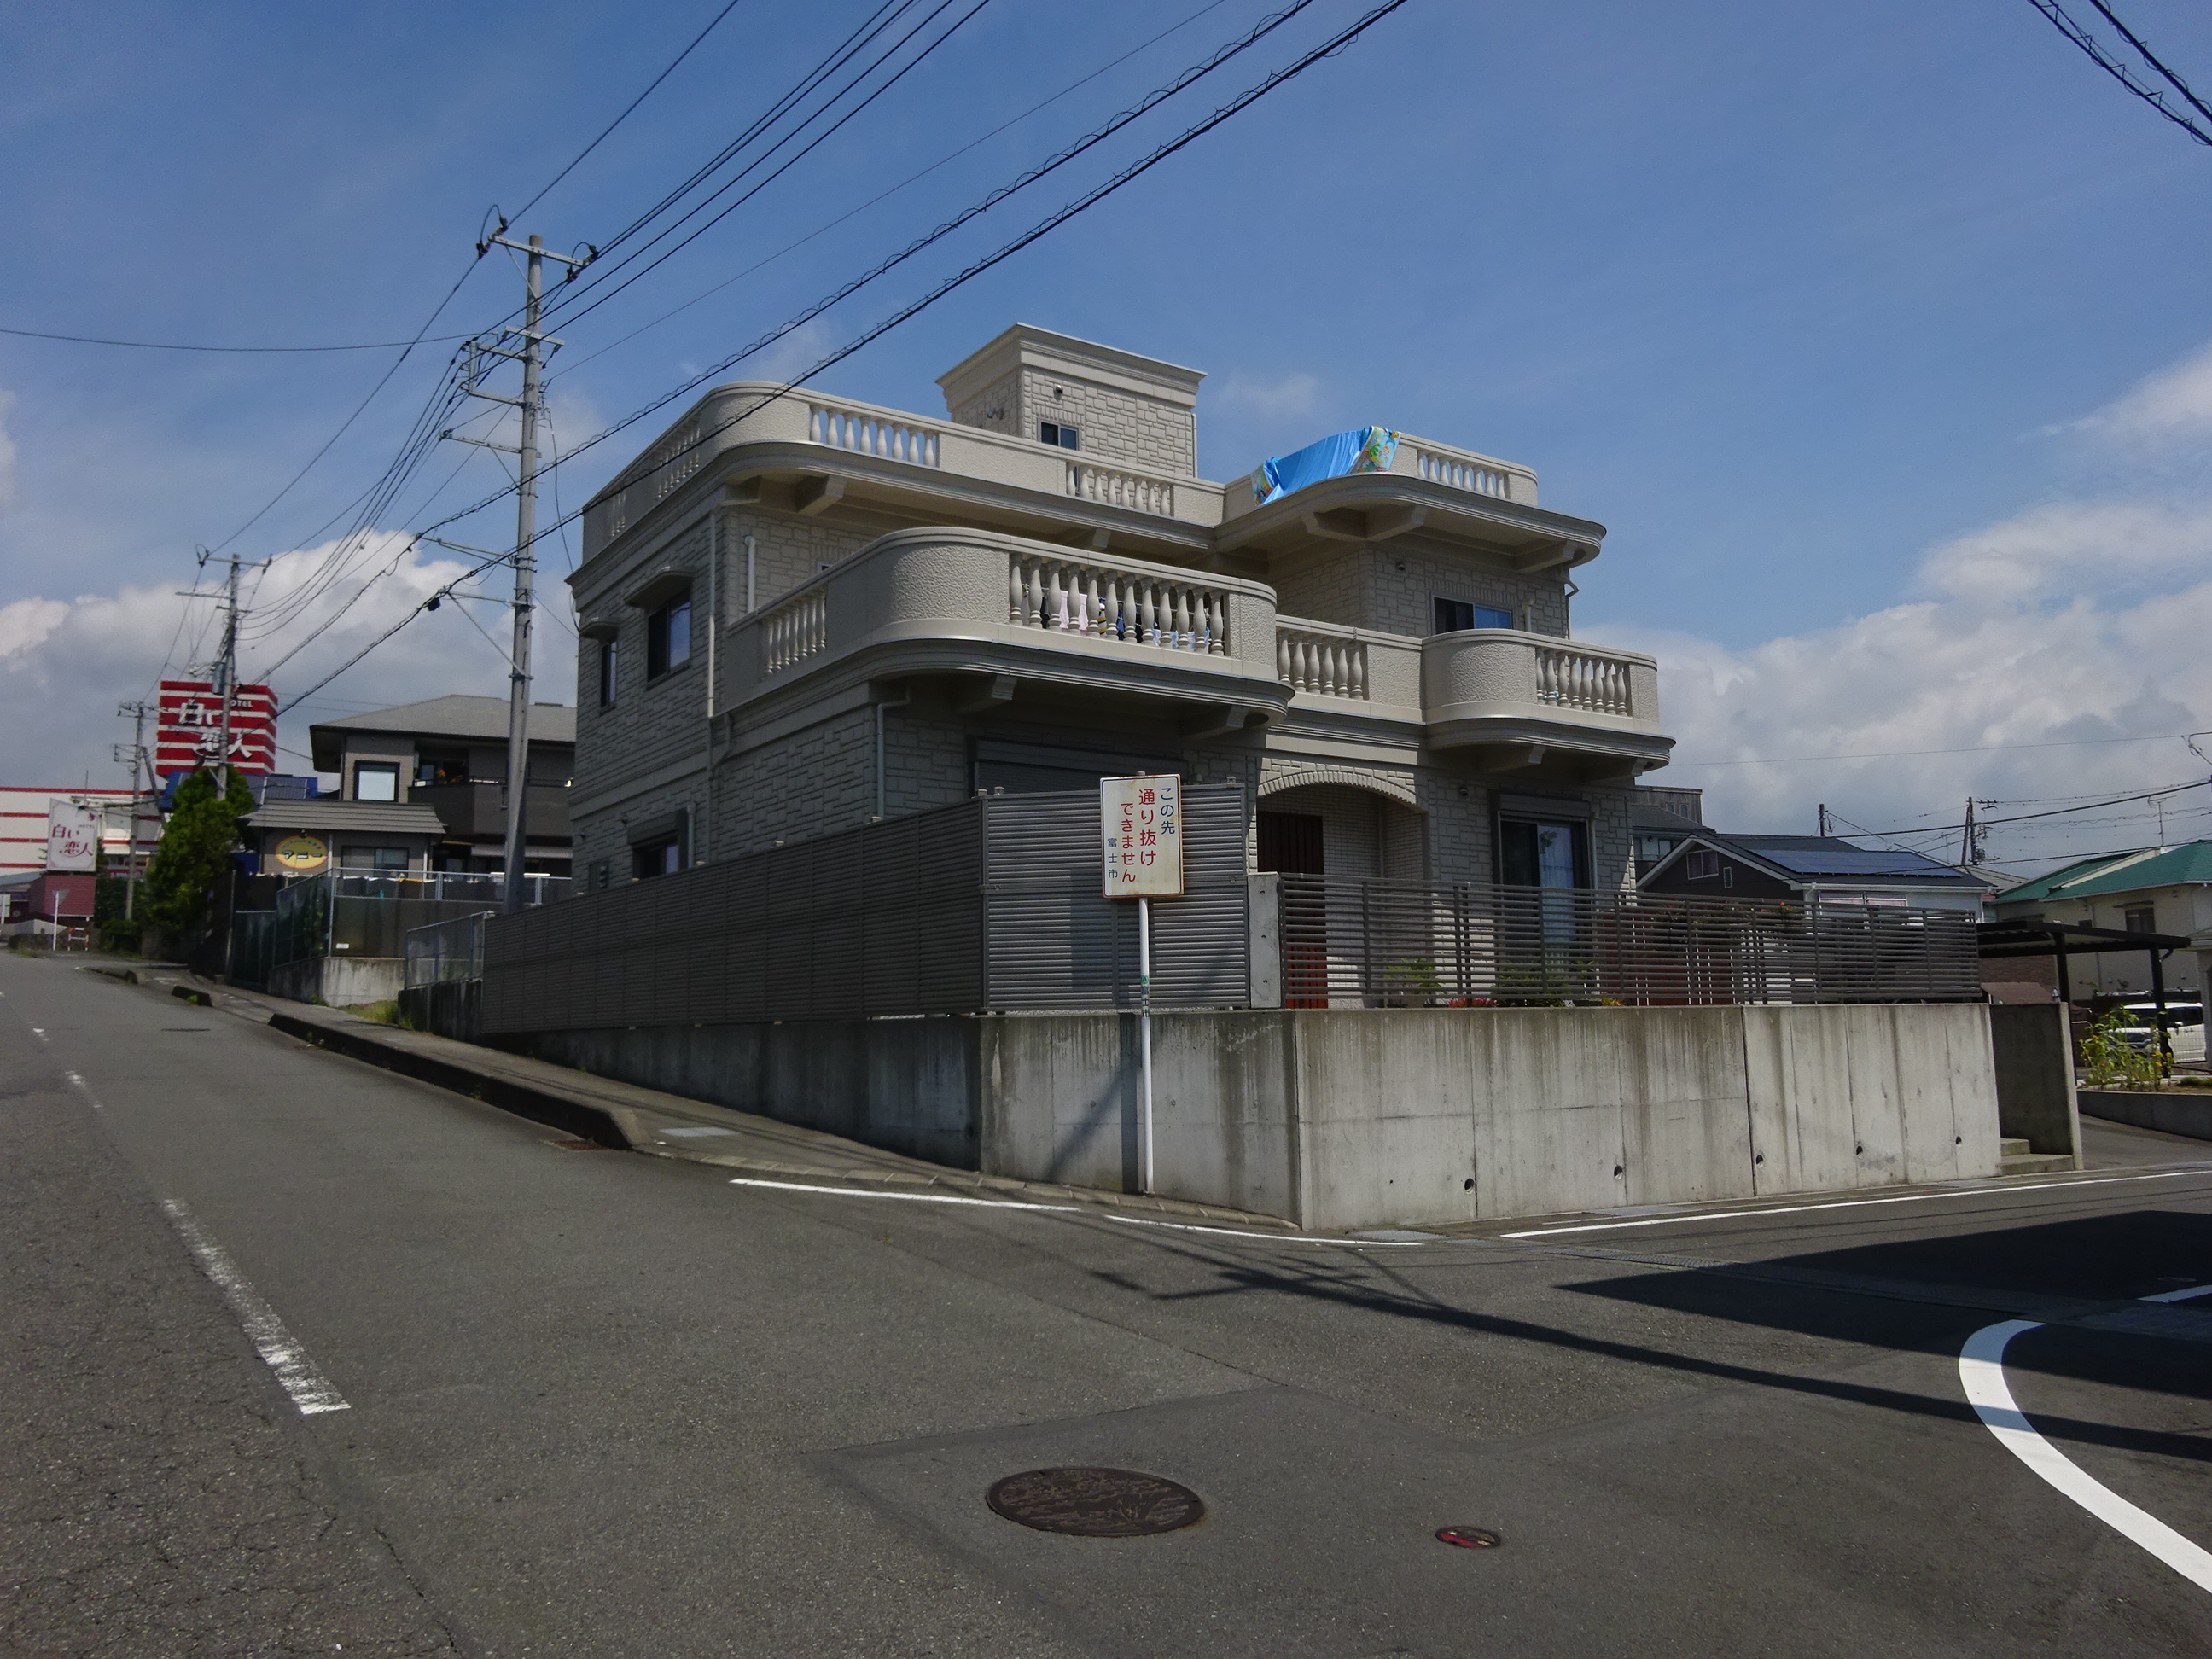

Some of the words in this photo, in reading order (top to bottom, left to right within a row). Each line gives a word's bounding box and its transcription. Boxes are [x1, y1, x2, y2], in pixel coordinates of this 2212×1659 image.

[52, 824, 79, 838] 白い
[1138, 789, 1157, 866] 通り抜け
[1160, 787, 1175, 835] この先
[59, 841, 93, 858] 恋人
[1107, 837, 1118, 879] 富士市
[1120, 802, 1136, 882] できません
